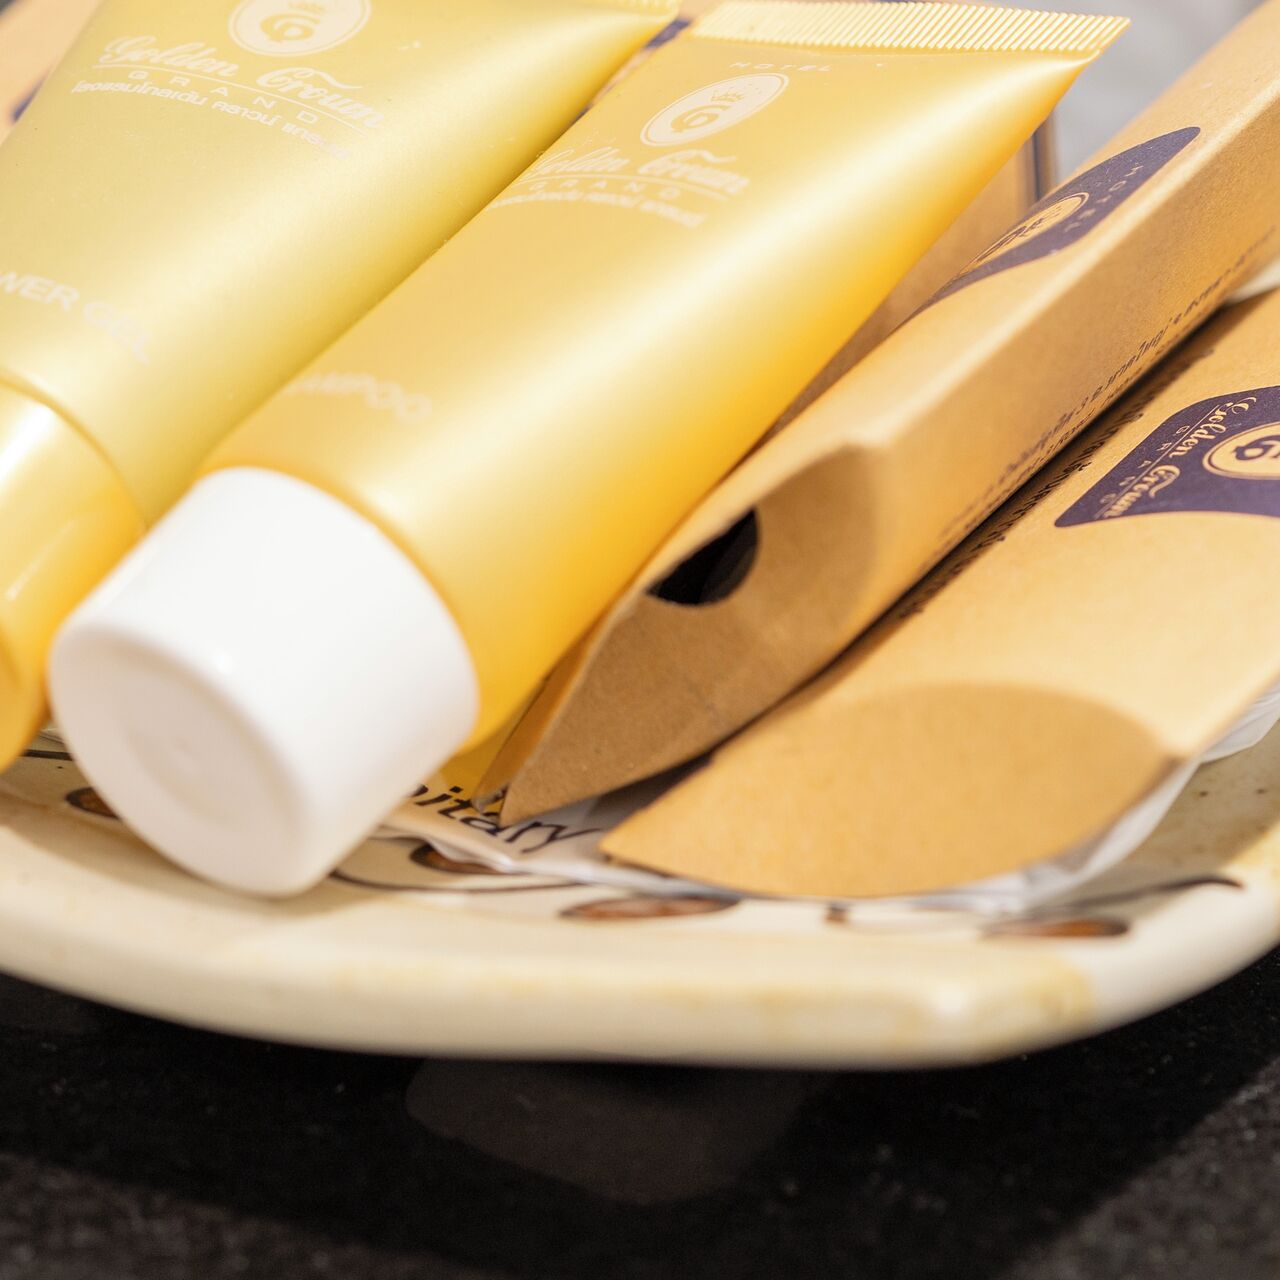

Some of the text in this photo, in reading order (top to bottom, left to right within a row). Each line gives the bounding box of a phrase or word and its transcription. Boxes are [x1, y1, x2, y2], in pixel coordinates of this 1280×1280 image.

[97, 35, 239, 77] Golden
[128, 70, 319, 125] GRAND
[1168, 396, 1258, 459] Golden
